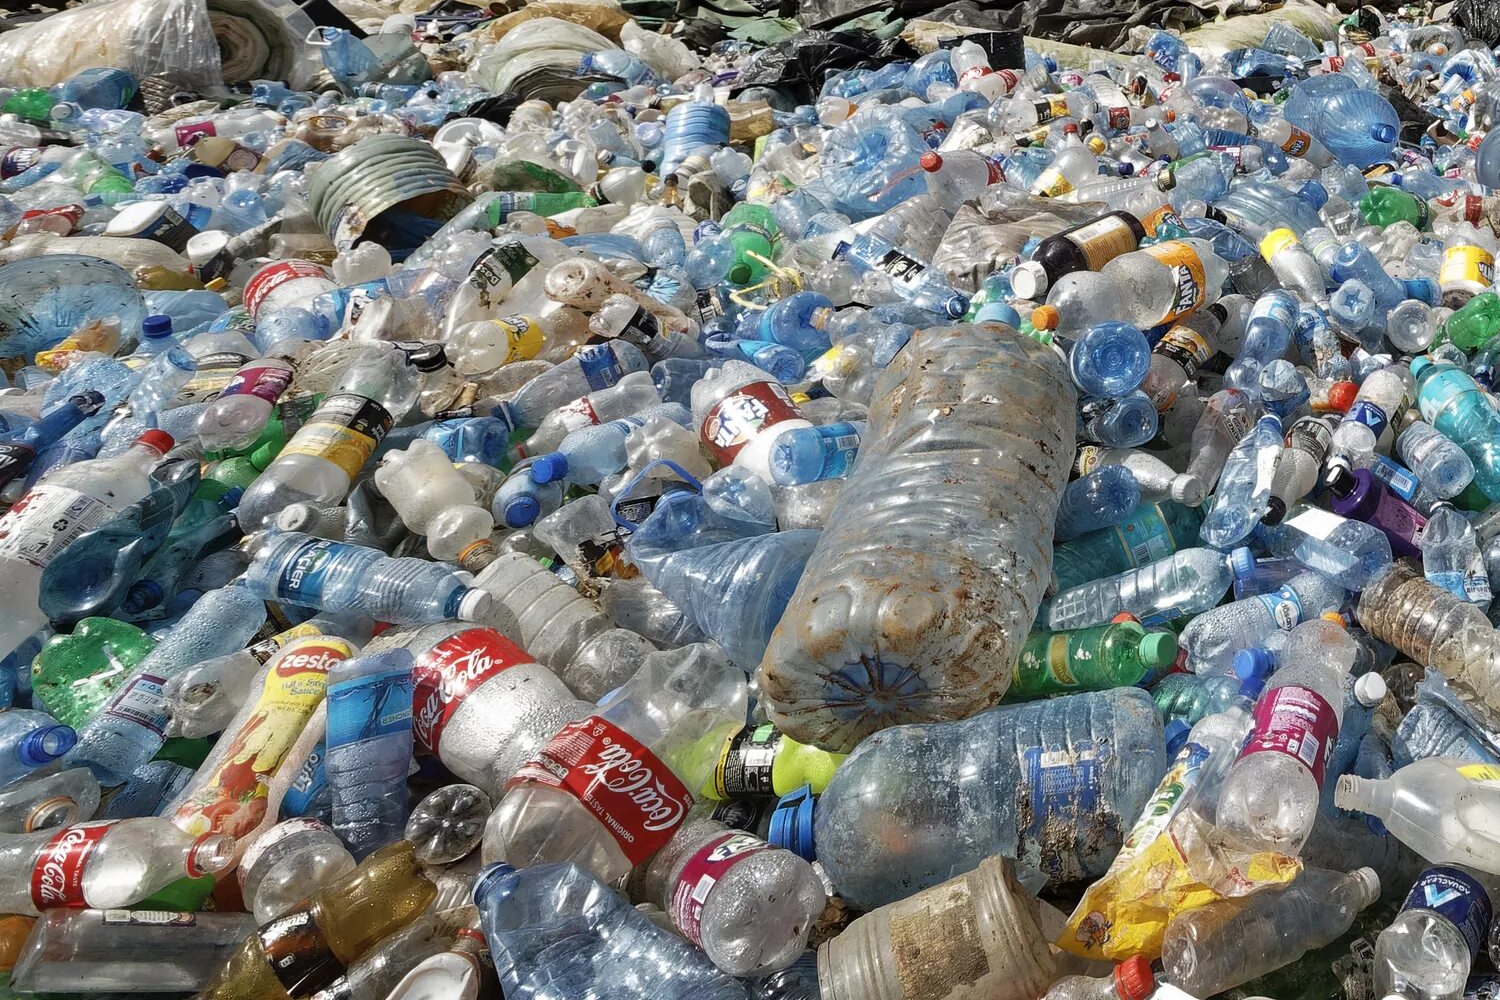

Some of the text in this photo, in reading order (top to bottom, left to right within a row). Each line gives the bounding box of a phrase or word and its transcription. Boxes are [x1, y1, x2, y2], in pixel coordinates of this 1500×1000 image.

[1176, 264, 1193, 316] FANTA
[289, 541, 331, 590] GLACIER
[578, 743, 684, 831] Coca-Cola
[585, 794, 635, 843] ORIGINAL TASTE
[41, 830, 86, 902] Coca-Cola
[1421, 878, 1471, 895] AQUACLEAR
